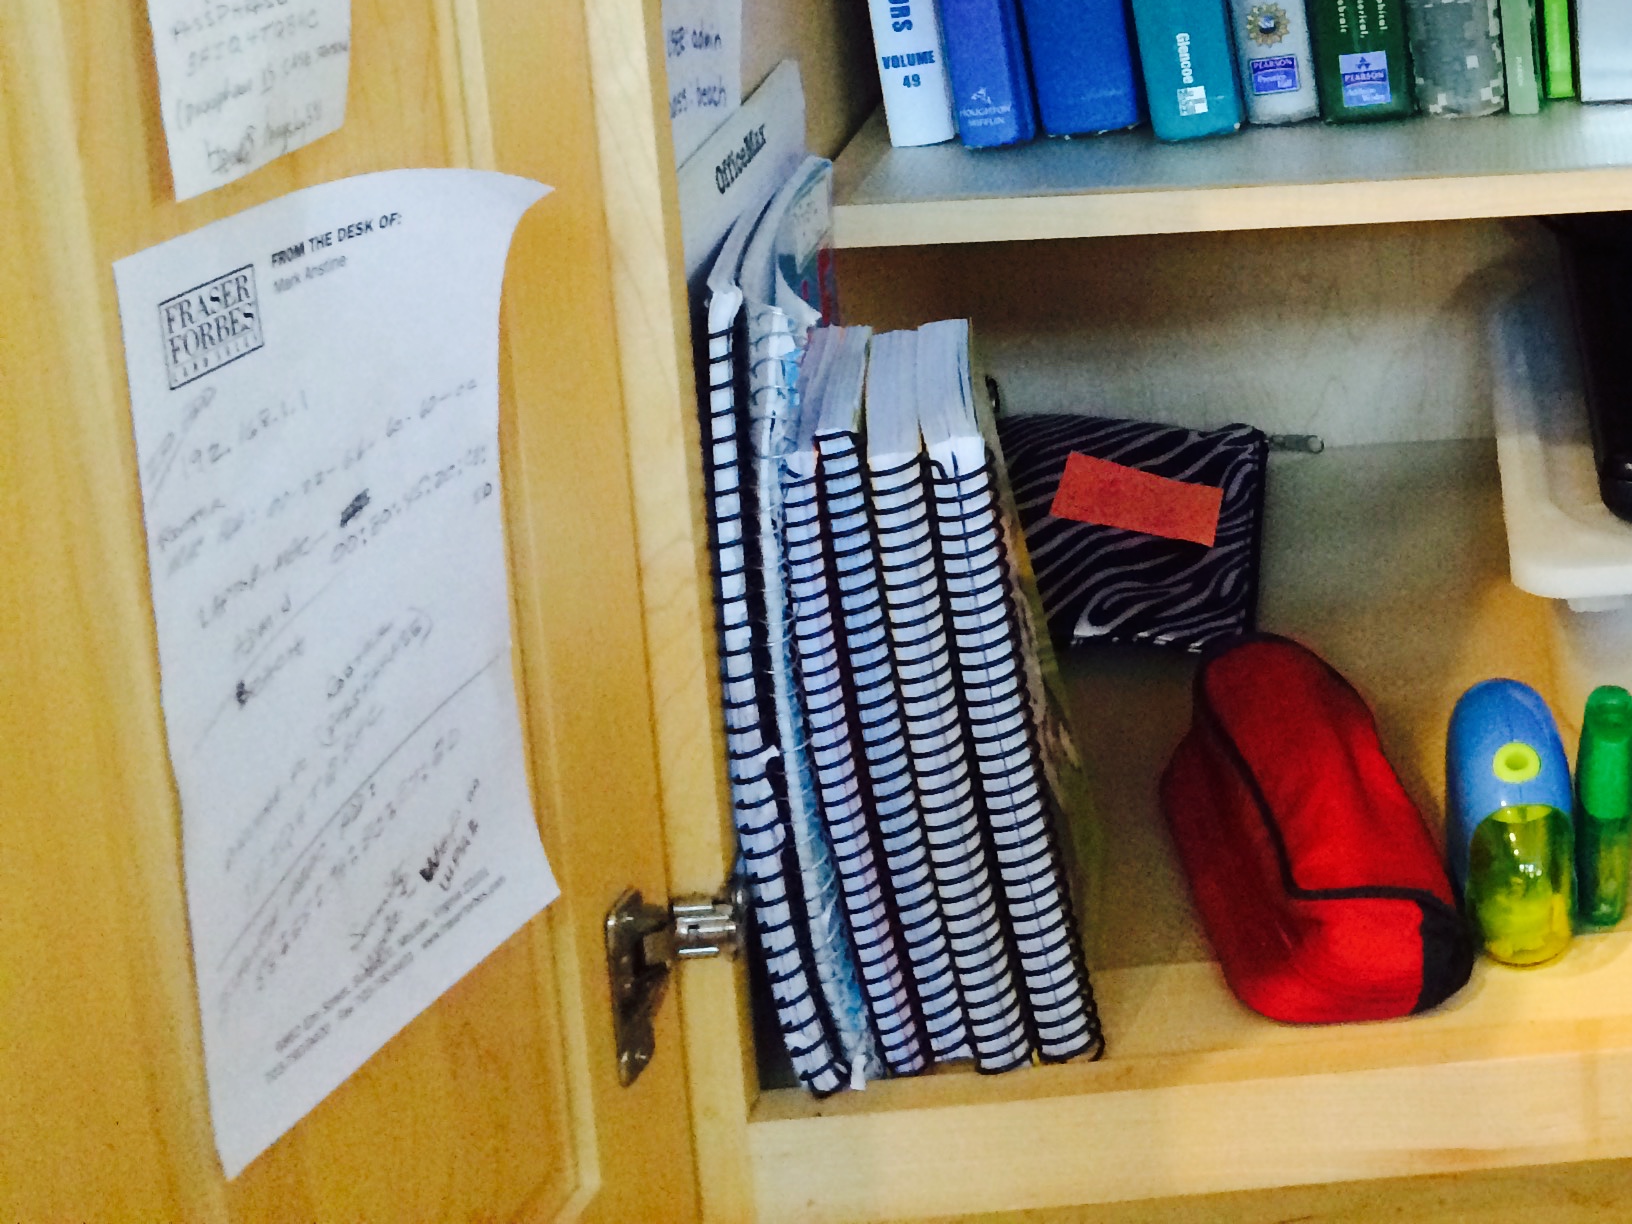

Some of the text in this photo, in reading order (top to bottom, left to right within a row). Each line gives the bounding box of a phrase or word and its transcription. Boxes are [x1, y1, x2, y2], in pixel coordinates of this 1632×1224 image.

[881, 50, 936, 70] VOLUME
[902, 73, 922, 89] 49
[1175, 32, 1194, 85] Glencoe
[1344, 71, 1385, 82] PEARSON
[715, 122, 767, 195] OfficeMax
[271, 212, 403, 268] FROM THE DESK OF:
[165, 273, 251, 335] FRASER
[169, 302, 255, 365] FORBES
